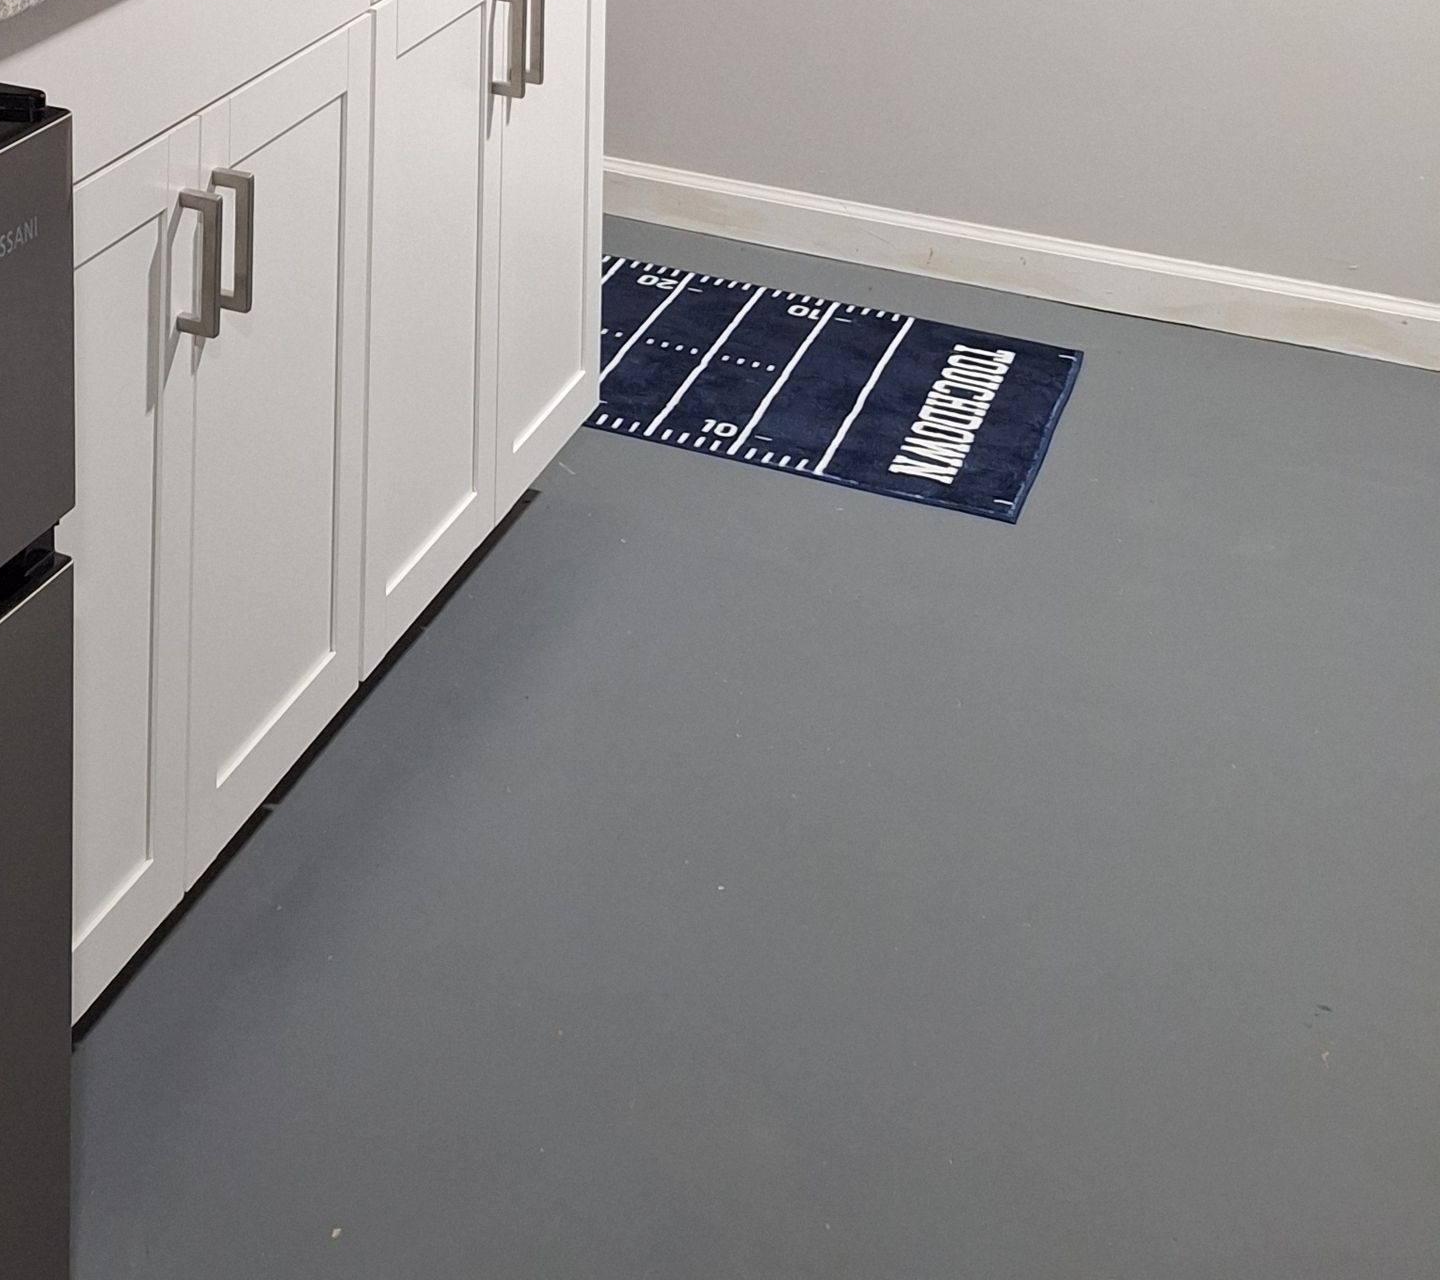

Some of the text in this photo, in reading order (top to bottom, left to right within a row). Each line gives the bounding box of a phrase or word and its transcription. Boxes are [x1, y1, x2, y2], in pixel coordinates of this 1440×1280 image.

[787, 304, 821, 320] 10
[888, 343, 1017, 484] TOUCHDOWN
[701, 418, 738, 437] 10
